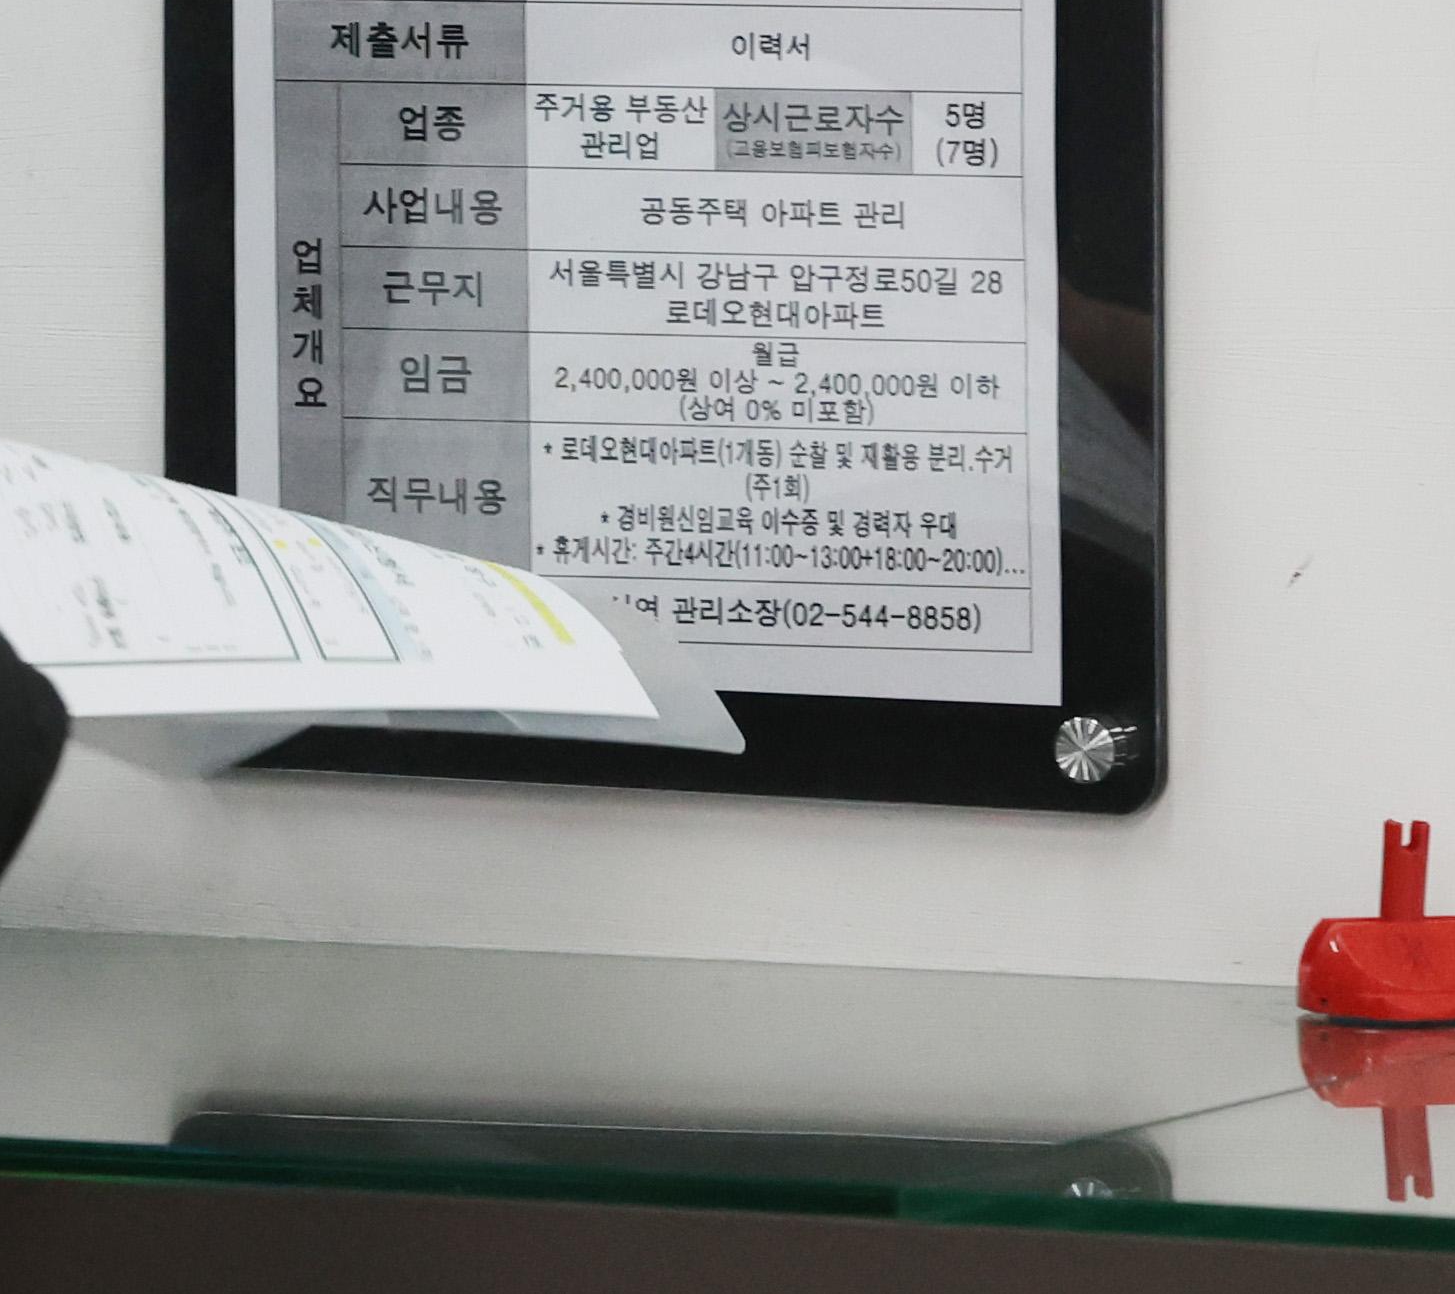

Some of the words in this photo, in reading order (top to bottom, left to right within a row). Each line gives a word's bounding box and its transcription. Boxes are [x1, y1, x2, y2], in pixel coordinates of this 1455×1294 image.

[731, 32, 810, 61] 이력서
[534, 92, 616, 123] 주거용
[625, 94, 708, 125] 부동산
[580, 131, 658, 161] 관리업
[549, 258, 684, 290] 서울특별시
[696, 262, 779, 292] 강남구
[790, 264, 957, 296] 압구정로50길
[971, 269, 1003, 295] 28
[672, 596, 981, 634] 관리소장(02-544-8858)
